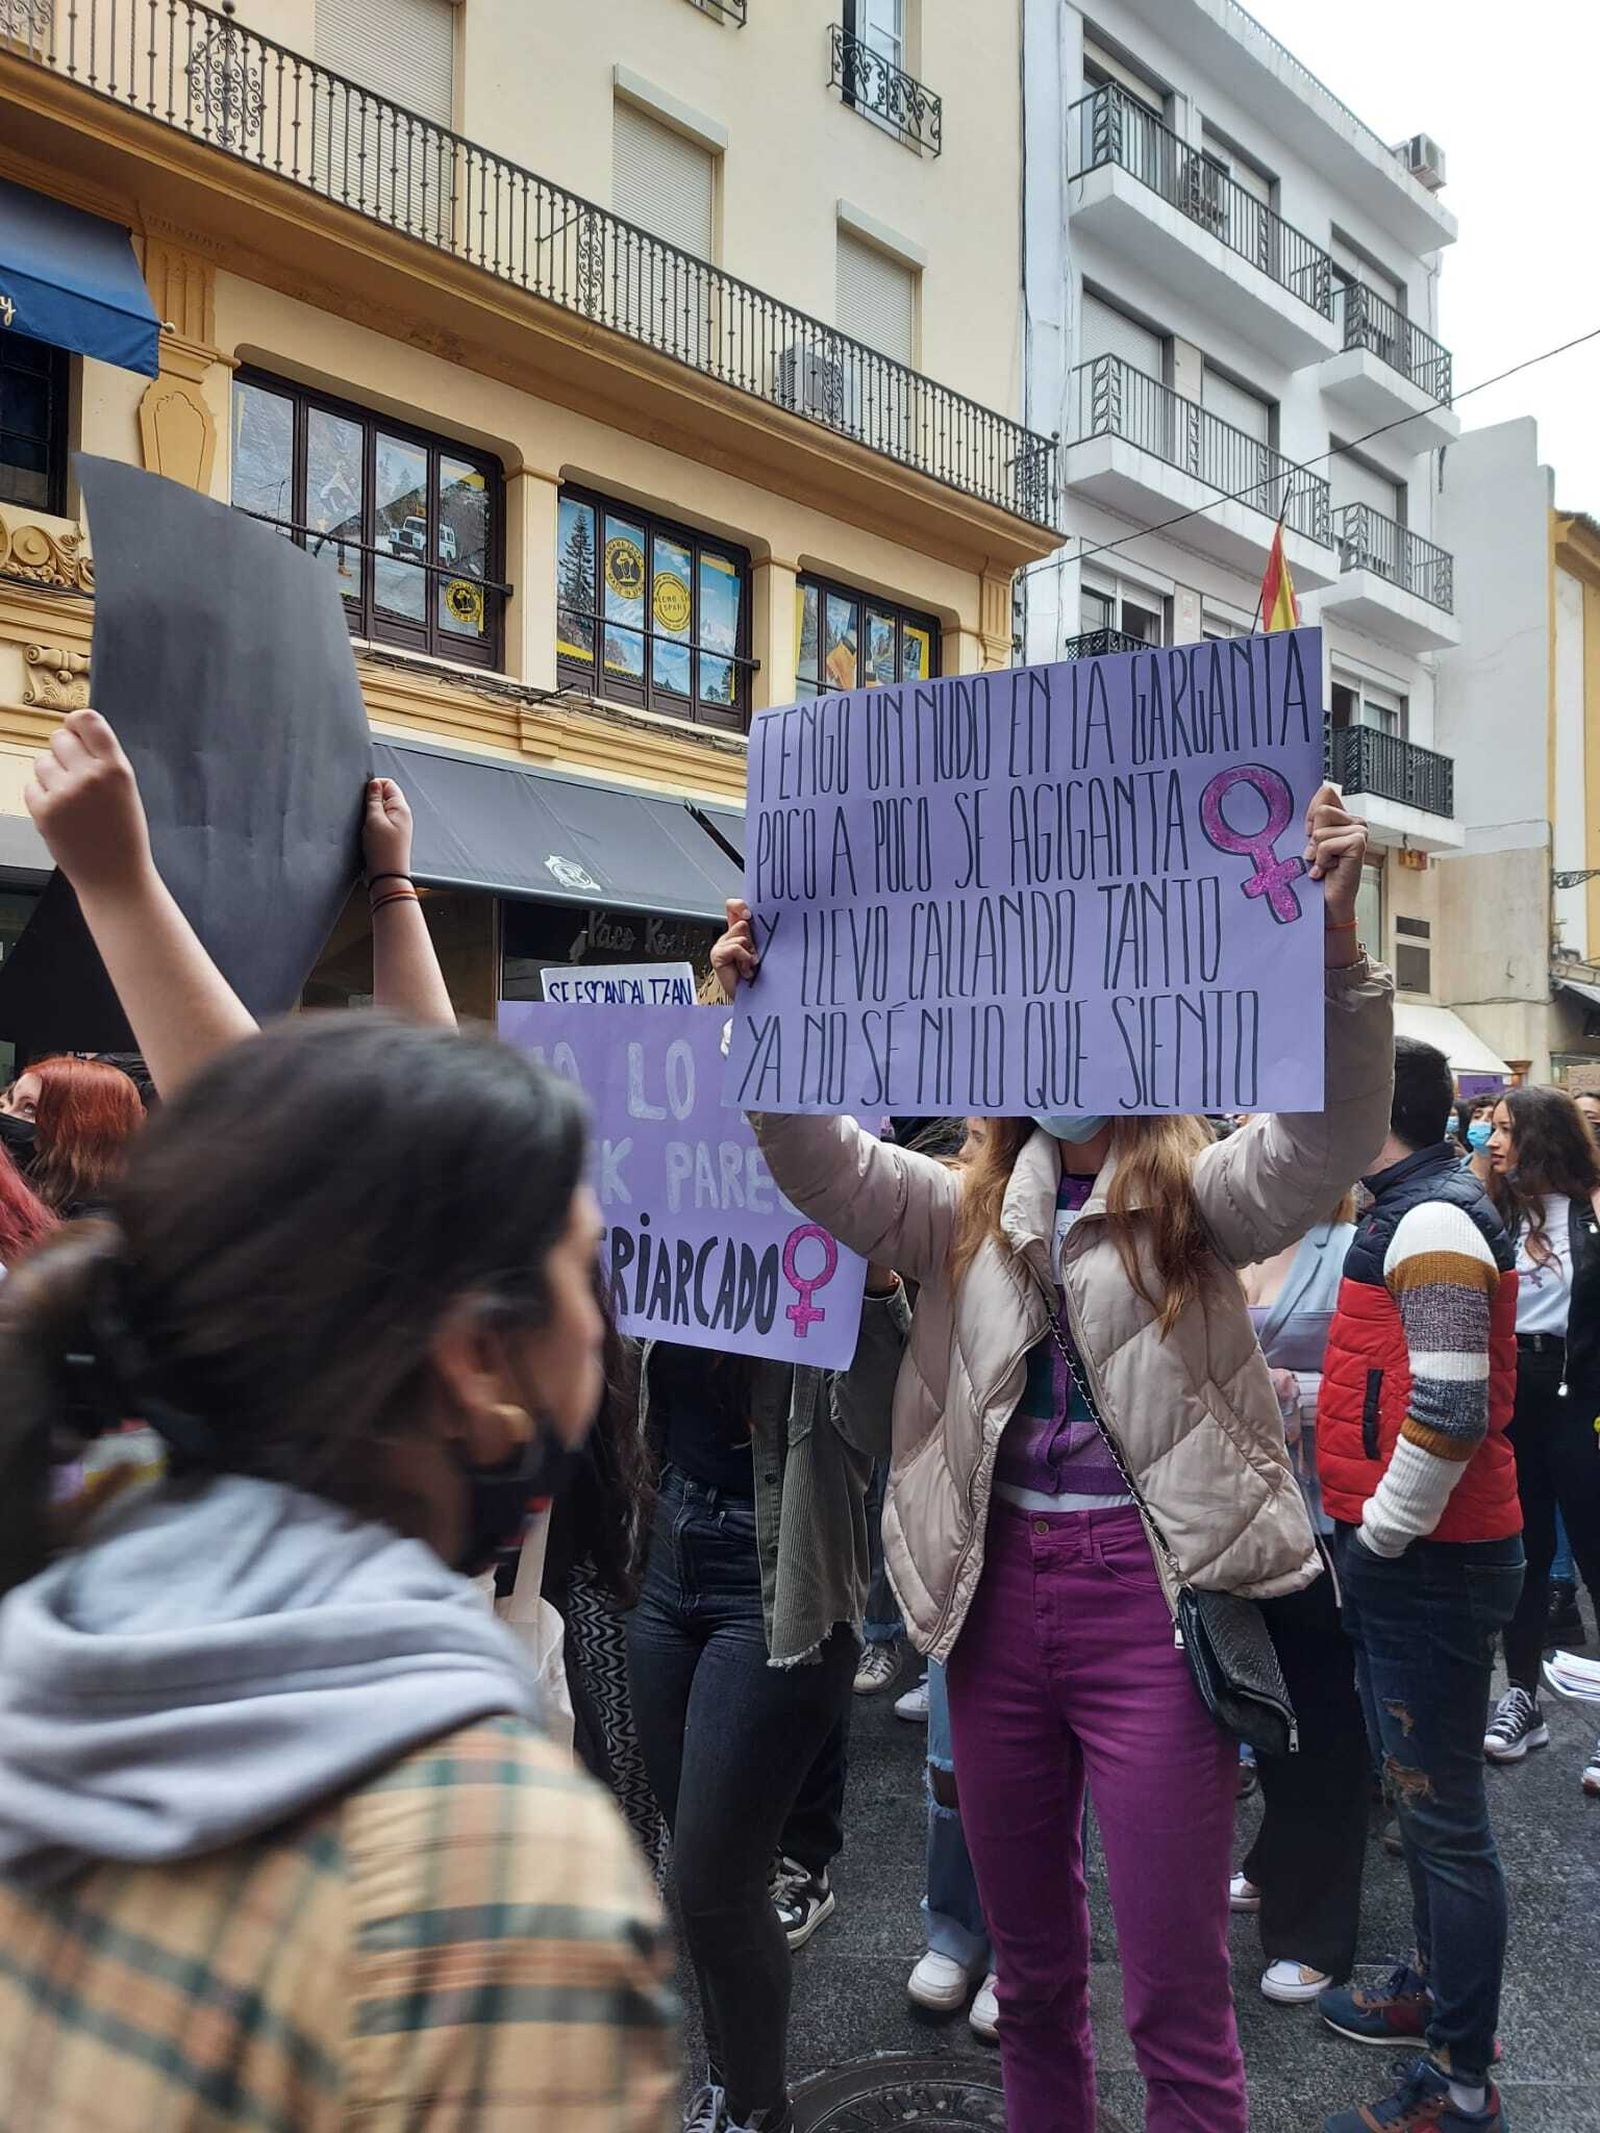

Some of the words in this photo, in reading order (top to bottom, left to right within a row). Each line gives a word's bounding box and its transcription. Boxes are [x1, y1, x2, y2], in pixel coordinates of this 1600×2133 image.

[757, 696, 851, 804] TENGO
[866, 689, 905, 791] UN
[914, 673, 991, 786] NUDO
[1008, 667, 1052, 779] EN
[1071, 660, 1115, 771] LA
[1130, 632, 1310, 764] GARGANTA
[756, 808, 817, 904] POCO
[830, 805, 858, 897] A
[872, 796, 932, 894] POCO
[954, 787, 990, 889] SE
[1008, 766, 1192, 886] AGIGANTA
[748, 911, 781, 990] Y
[800, 905, 889, 1008] LLEVO
[908, 886, 1076, 1001] CALLANDO
[1096, 875, 1222, 991] TANTO
[627, 1039, 696, 1121] LO
[736, 1014, 782, 1104] YA
[798, 1011, 848, 1106] NO
[860, 1001, 906, 1107] SÉ
[916, 1006, 954, 1106] NI
[968, 1004, 1005, 1108] LO
[1023, 999, 1089, 1110] QUE
[1111, 989, 1259, 1110] SIENTO
[666, 1140, 803, 1216] PARE
